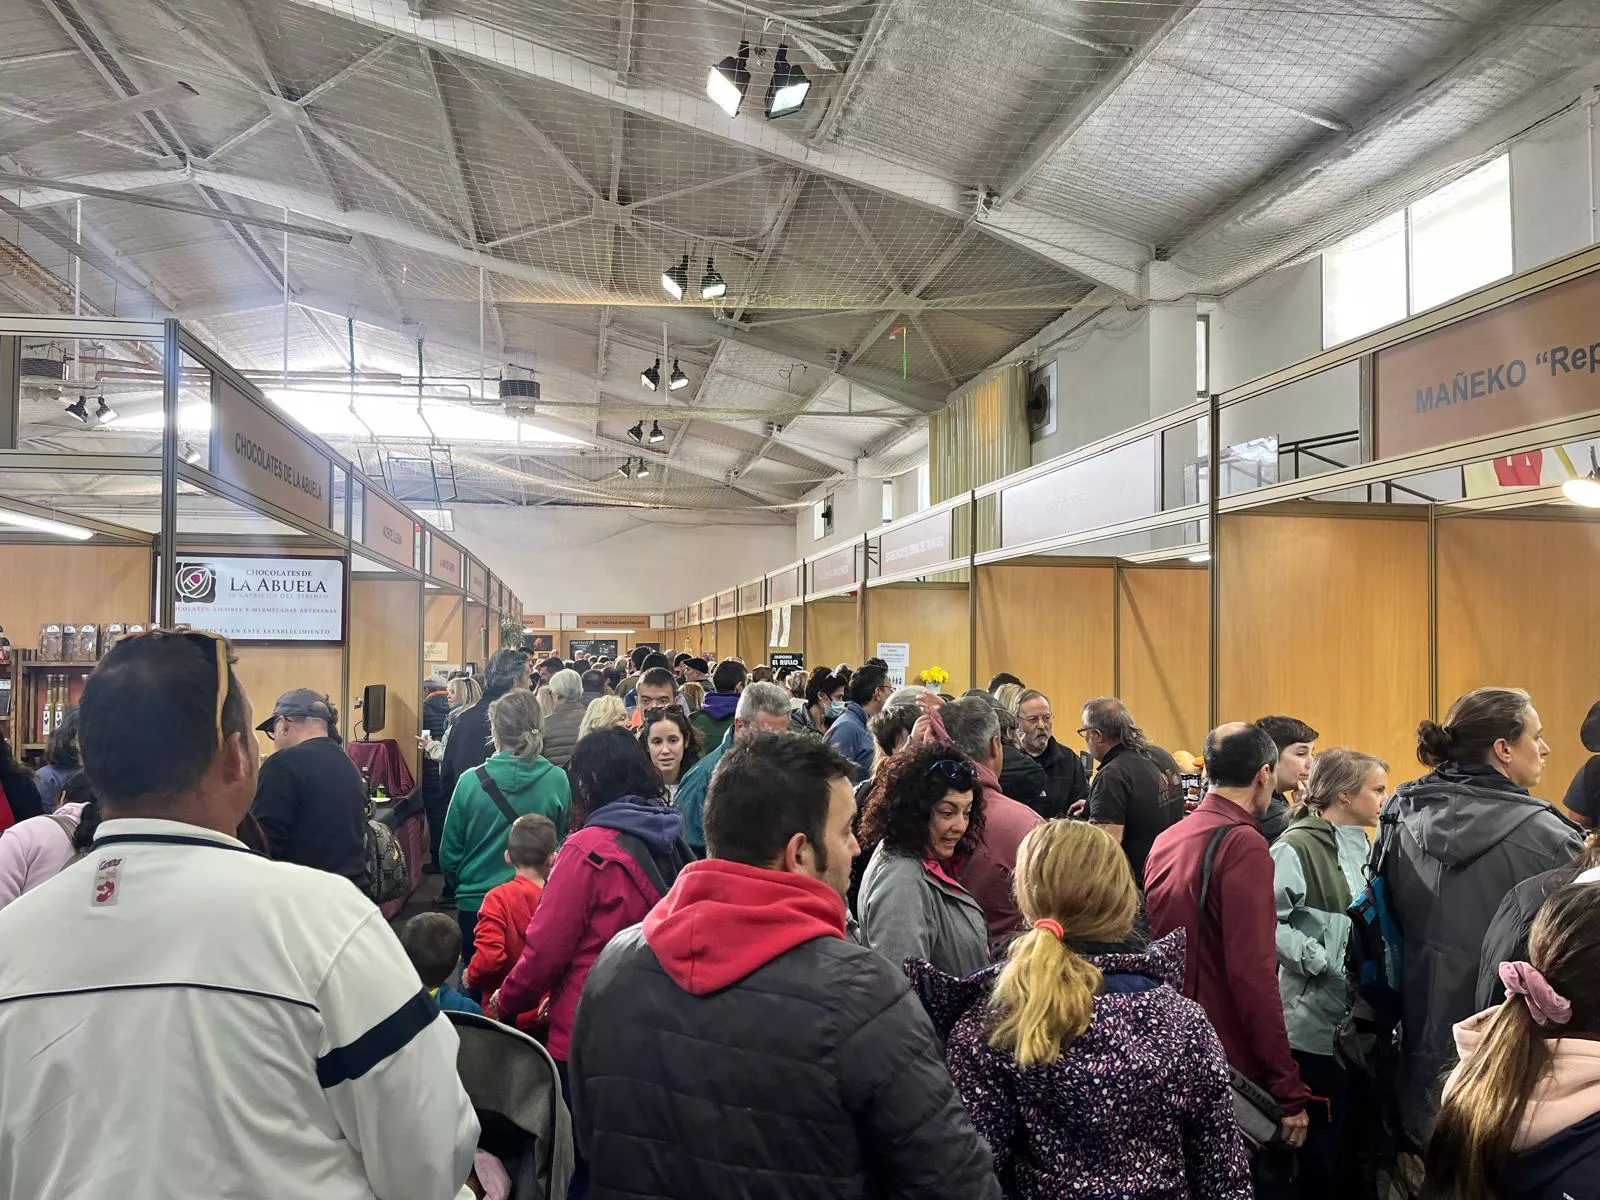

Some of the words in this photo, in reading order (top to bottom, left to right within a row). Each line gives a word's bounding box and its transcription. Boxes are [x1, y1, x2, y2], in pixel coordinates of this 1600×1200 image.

[1416, 359, 1527, 415] MAÑEKO
[235, 433, 282, 479] CHOCOLATES
[283, 463, 292, 485] DE
[292, 470, 301, 489] LA
[301, 474, 322, 500] ABUELA
[230, 577, 251, 592] LA
[257, 577, 327, 593] ABUELA
[246, 569, 301, 577] CHOCOLATES
